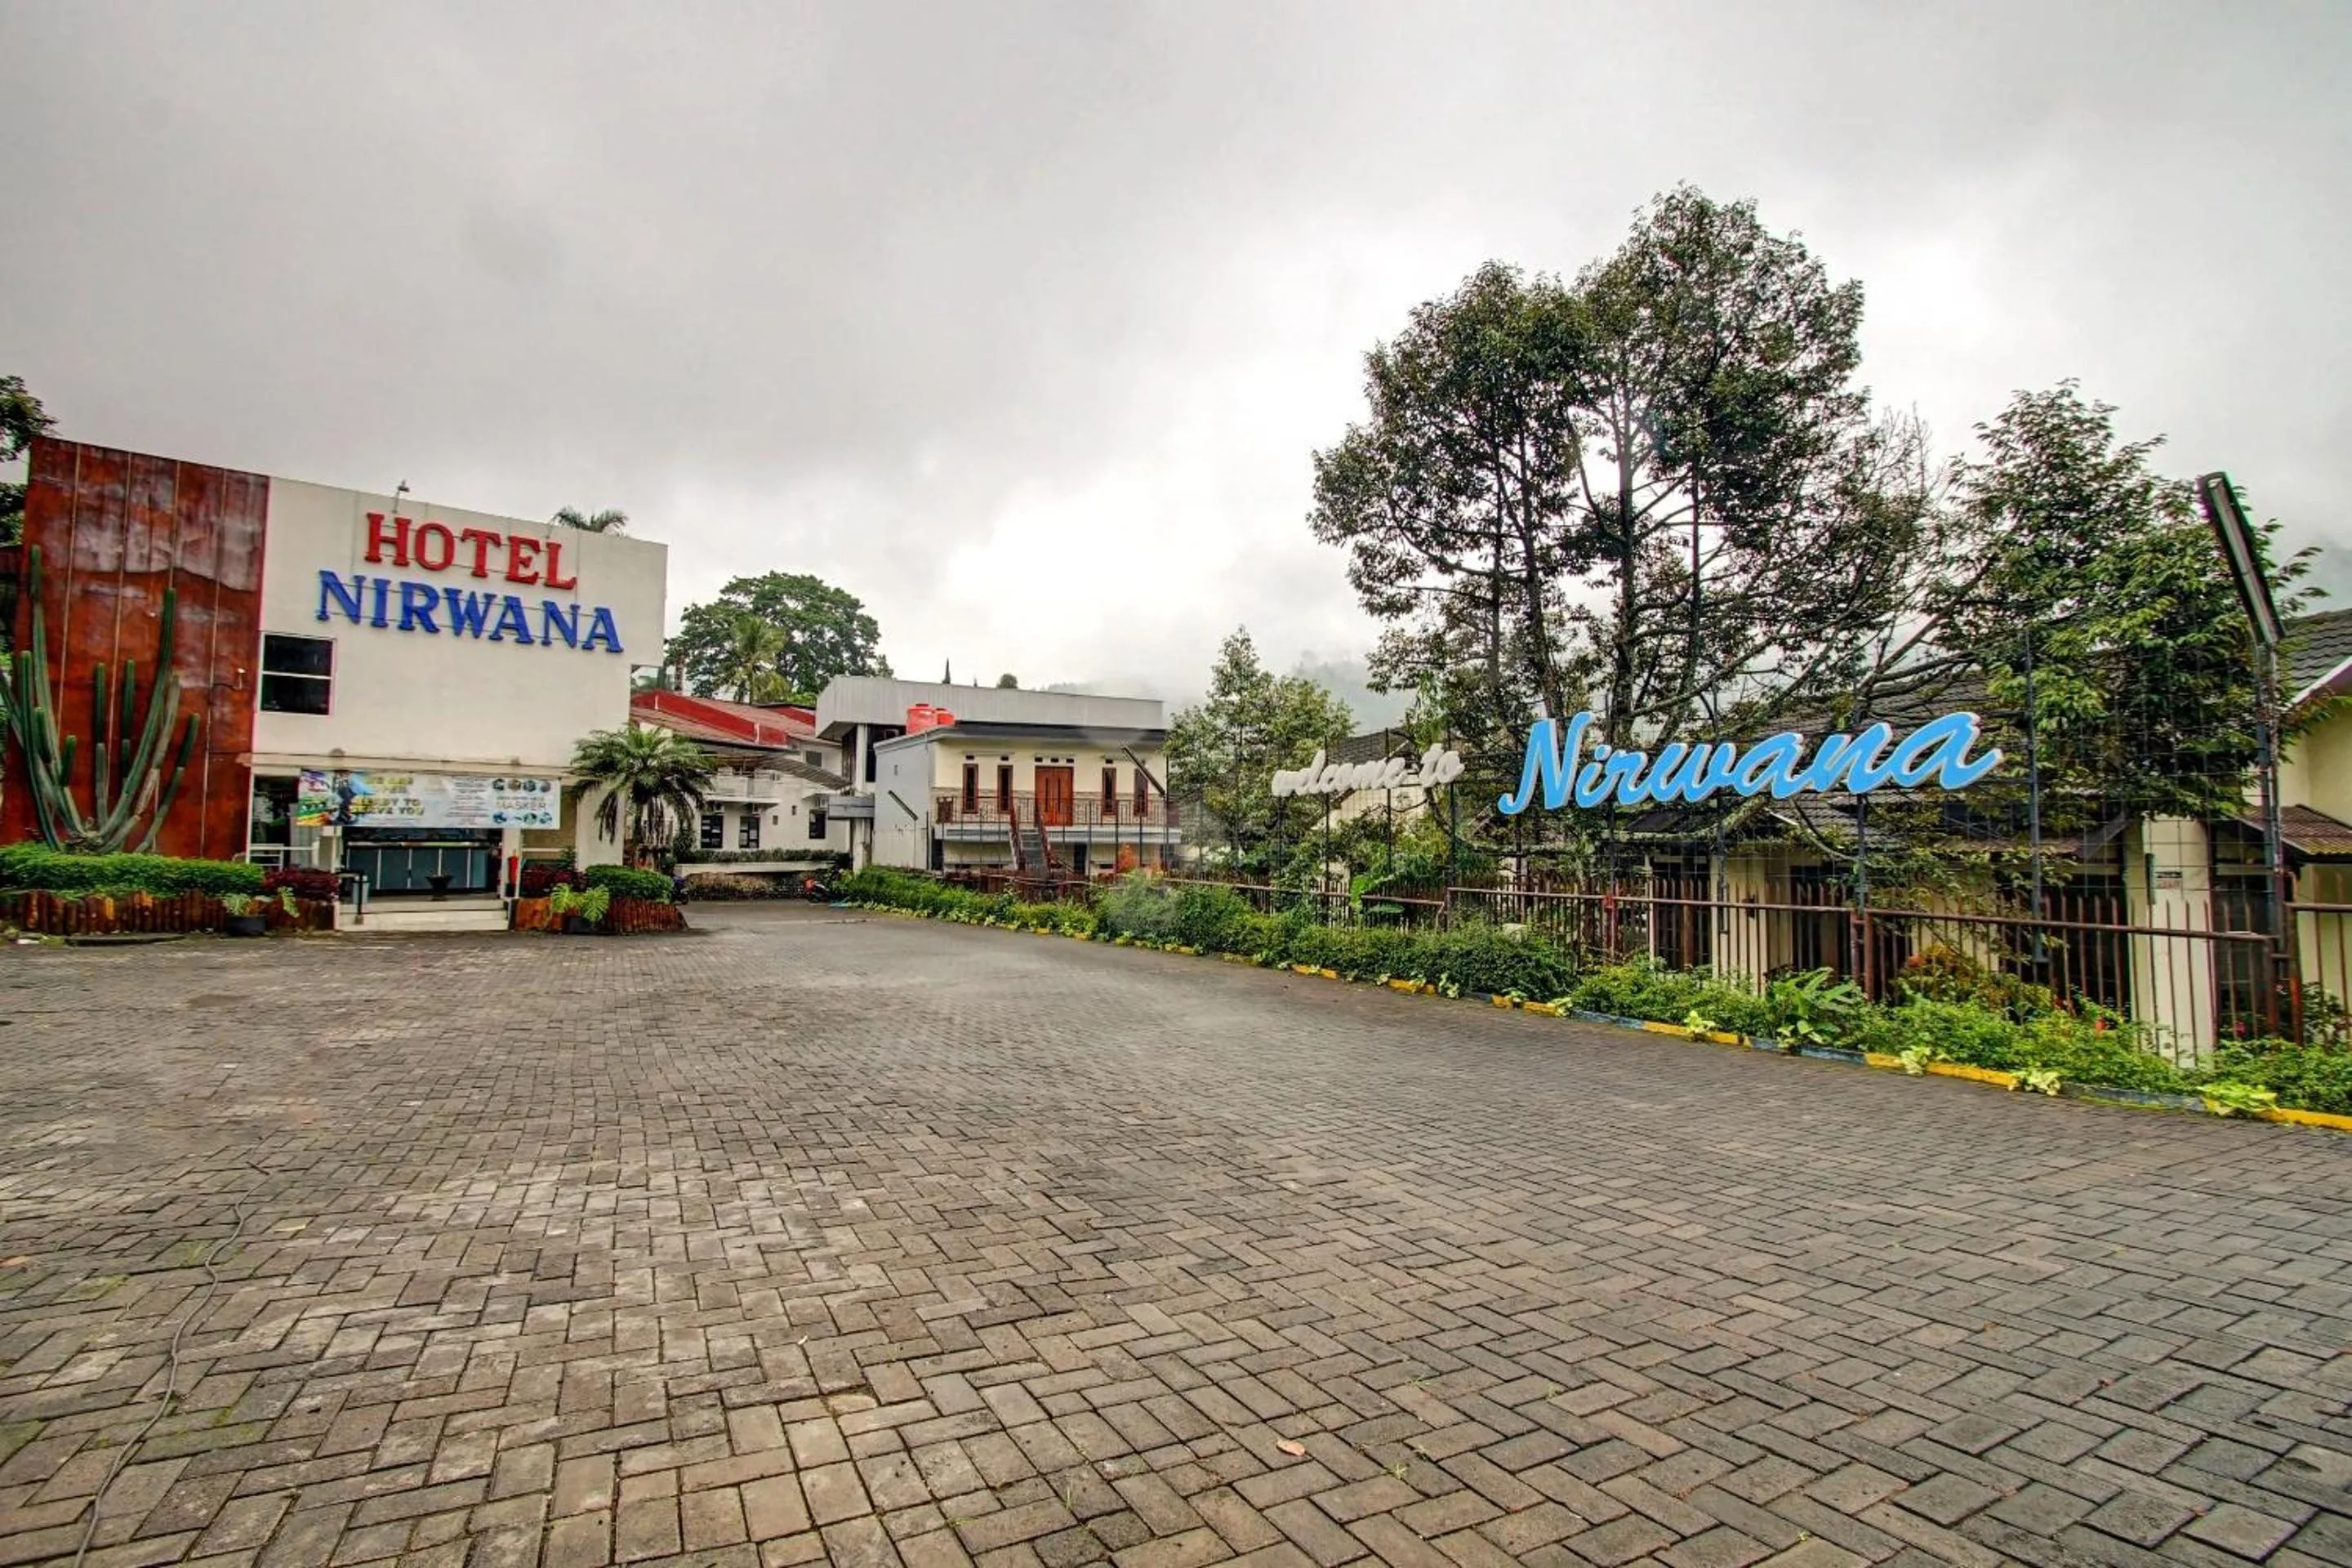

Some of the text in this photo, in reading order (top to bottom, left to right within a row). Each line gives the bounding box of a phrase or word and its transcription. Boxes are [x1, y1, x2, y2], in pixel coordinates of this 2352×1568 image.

[364, 512, 577, 590] HOTEL
[317, 570, 624, 653] NIRWANA
[1419, 743, 1465, 788] to
[1497, 710, 2003, 815] Nirwana
[399, 807, 425, 815] YOU
[496, 800, 546, 811] MASKER
